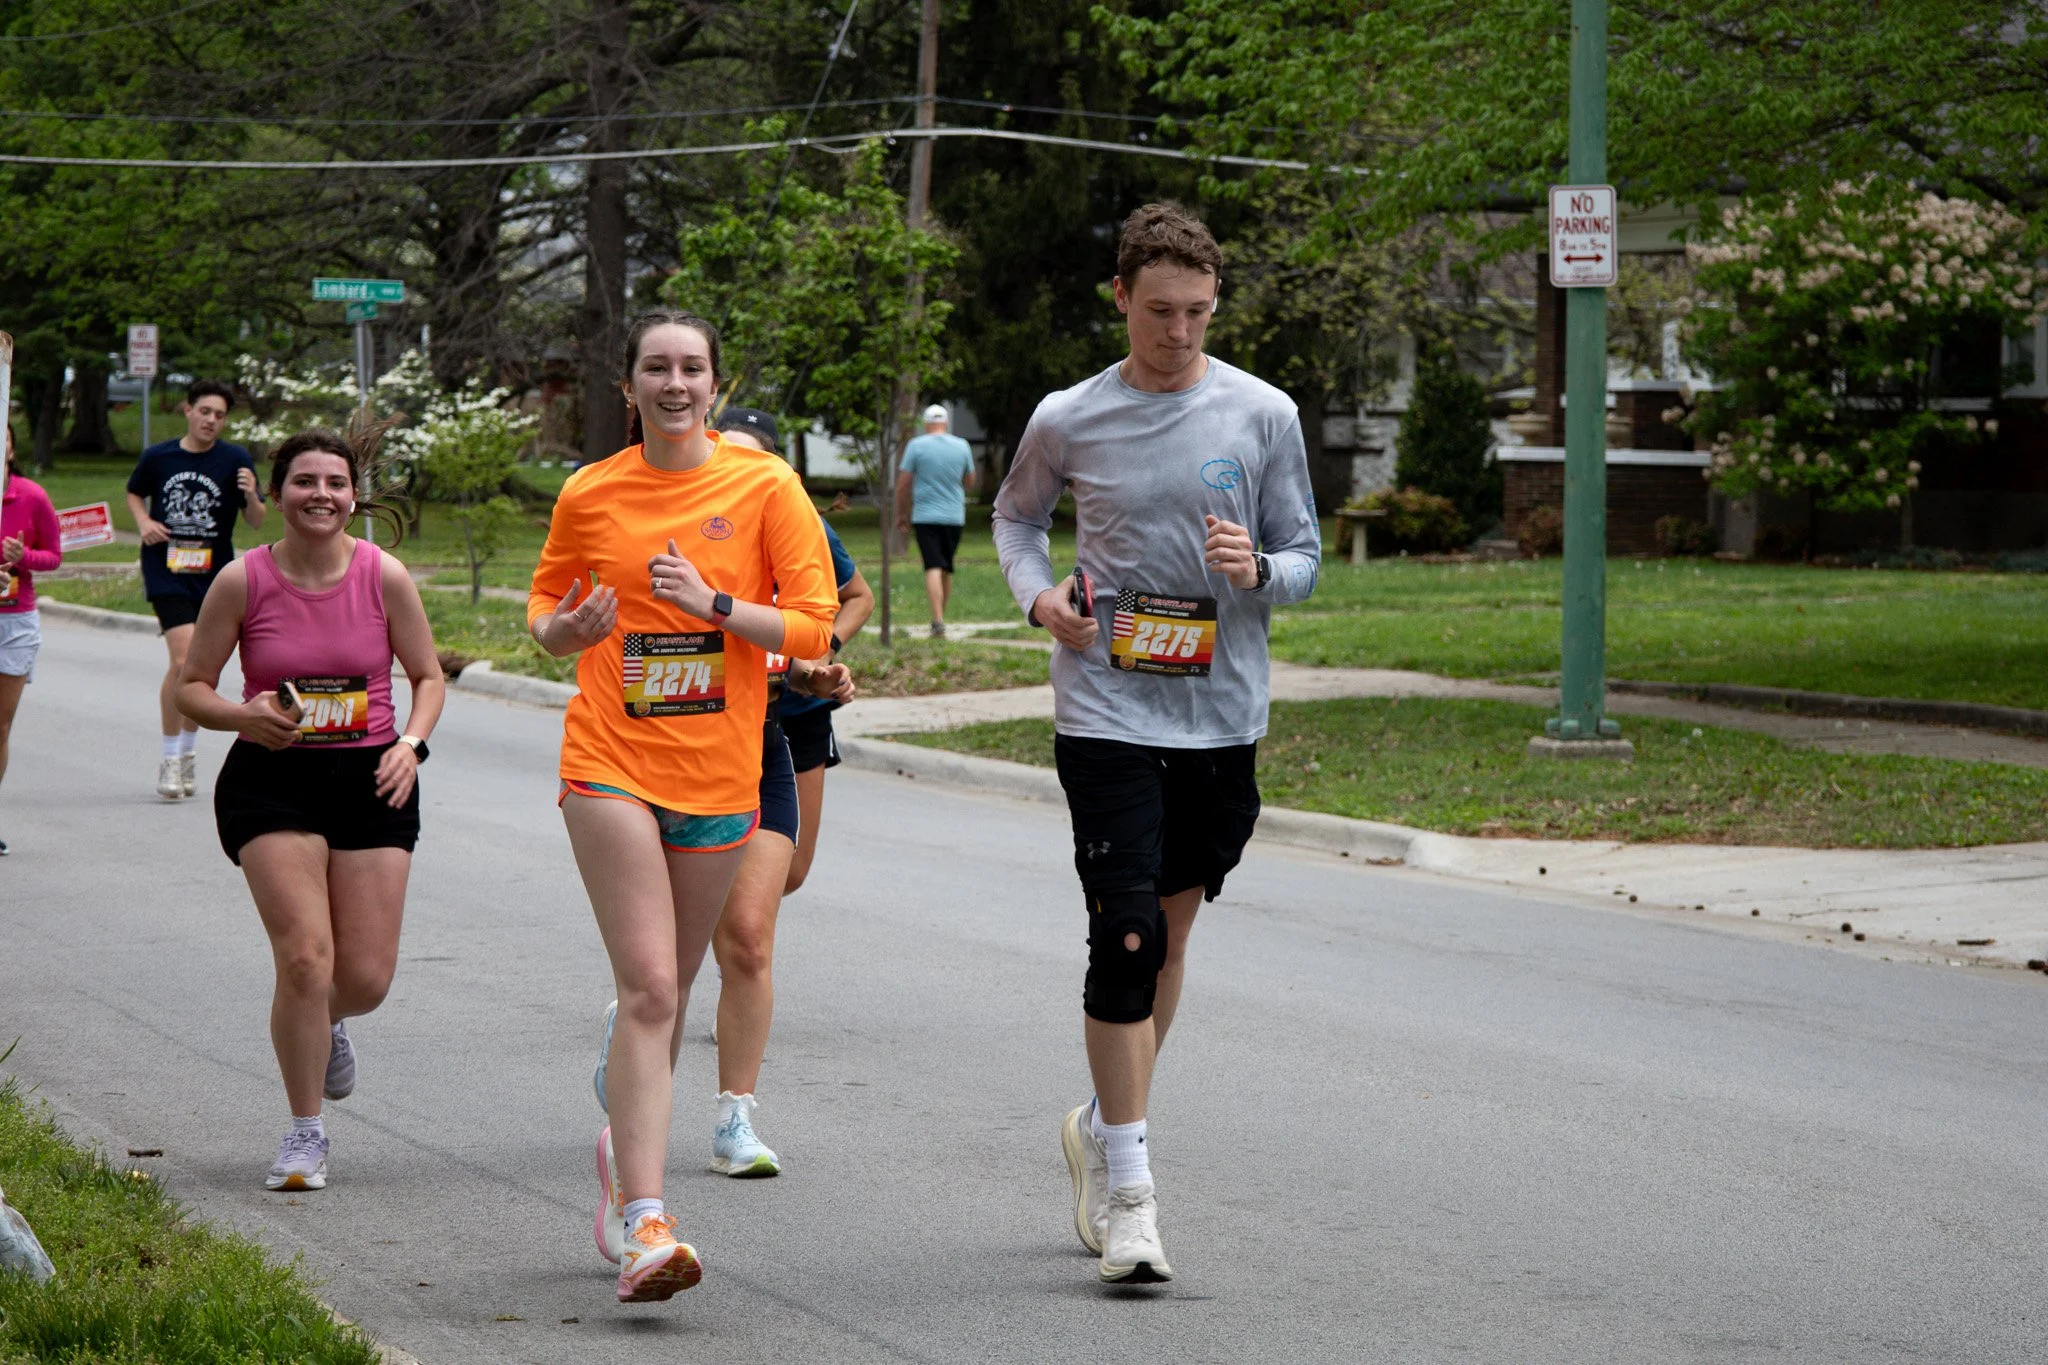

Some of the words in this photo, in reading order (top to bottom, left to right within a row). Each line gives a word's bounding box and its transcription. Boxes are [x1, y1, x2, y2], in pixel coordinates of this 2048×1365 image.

[1571, 195, 1594, 214] NO
[1555, 217, 1610, 235] PARKING
[314, 282, 367, 299] Lombard
[1150, 598, 1198, 610] HEARTLAND
[656, 636, 705, 646] HEARTLAND
[1131, 621, 1203, 658] 2275
[644, 661, 711, 696] 2274
[299, 698, 355, 728] 2041
